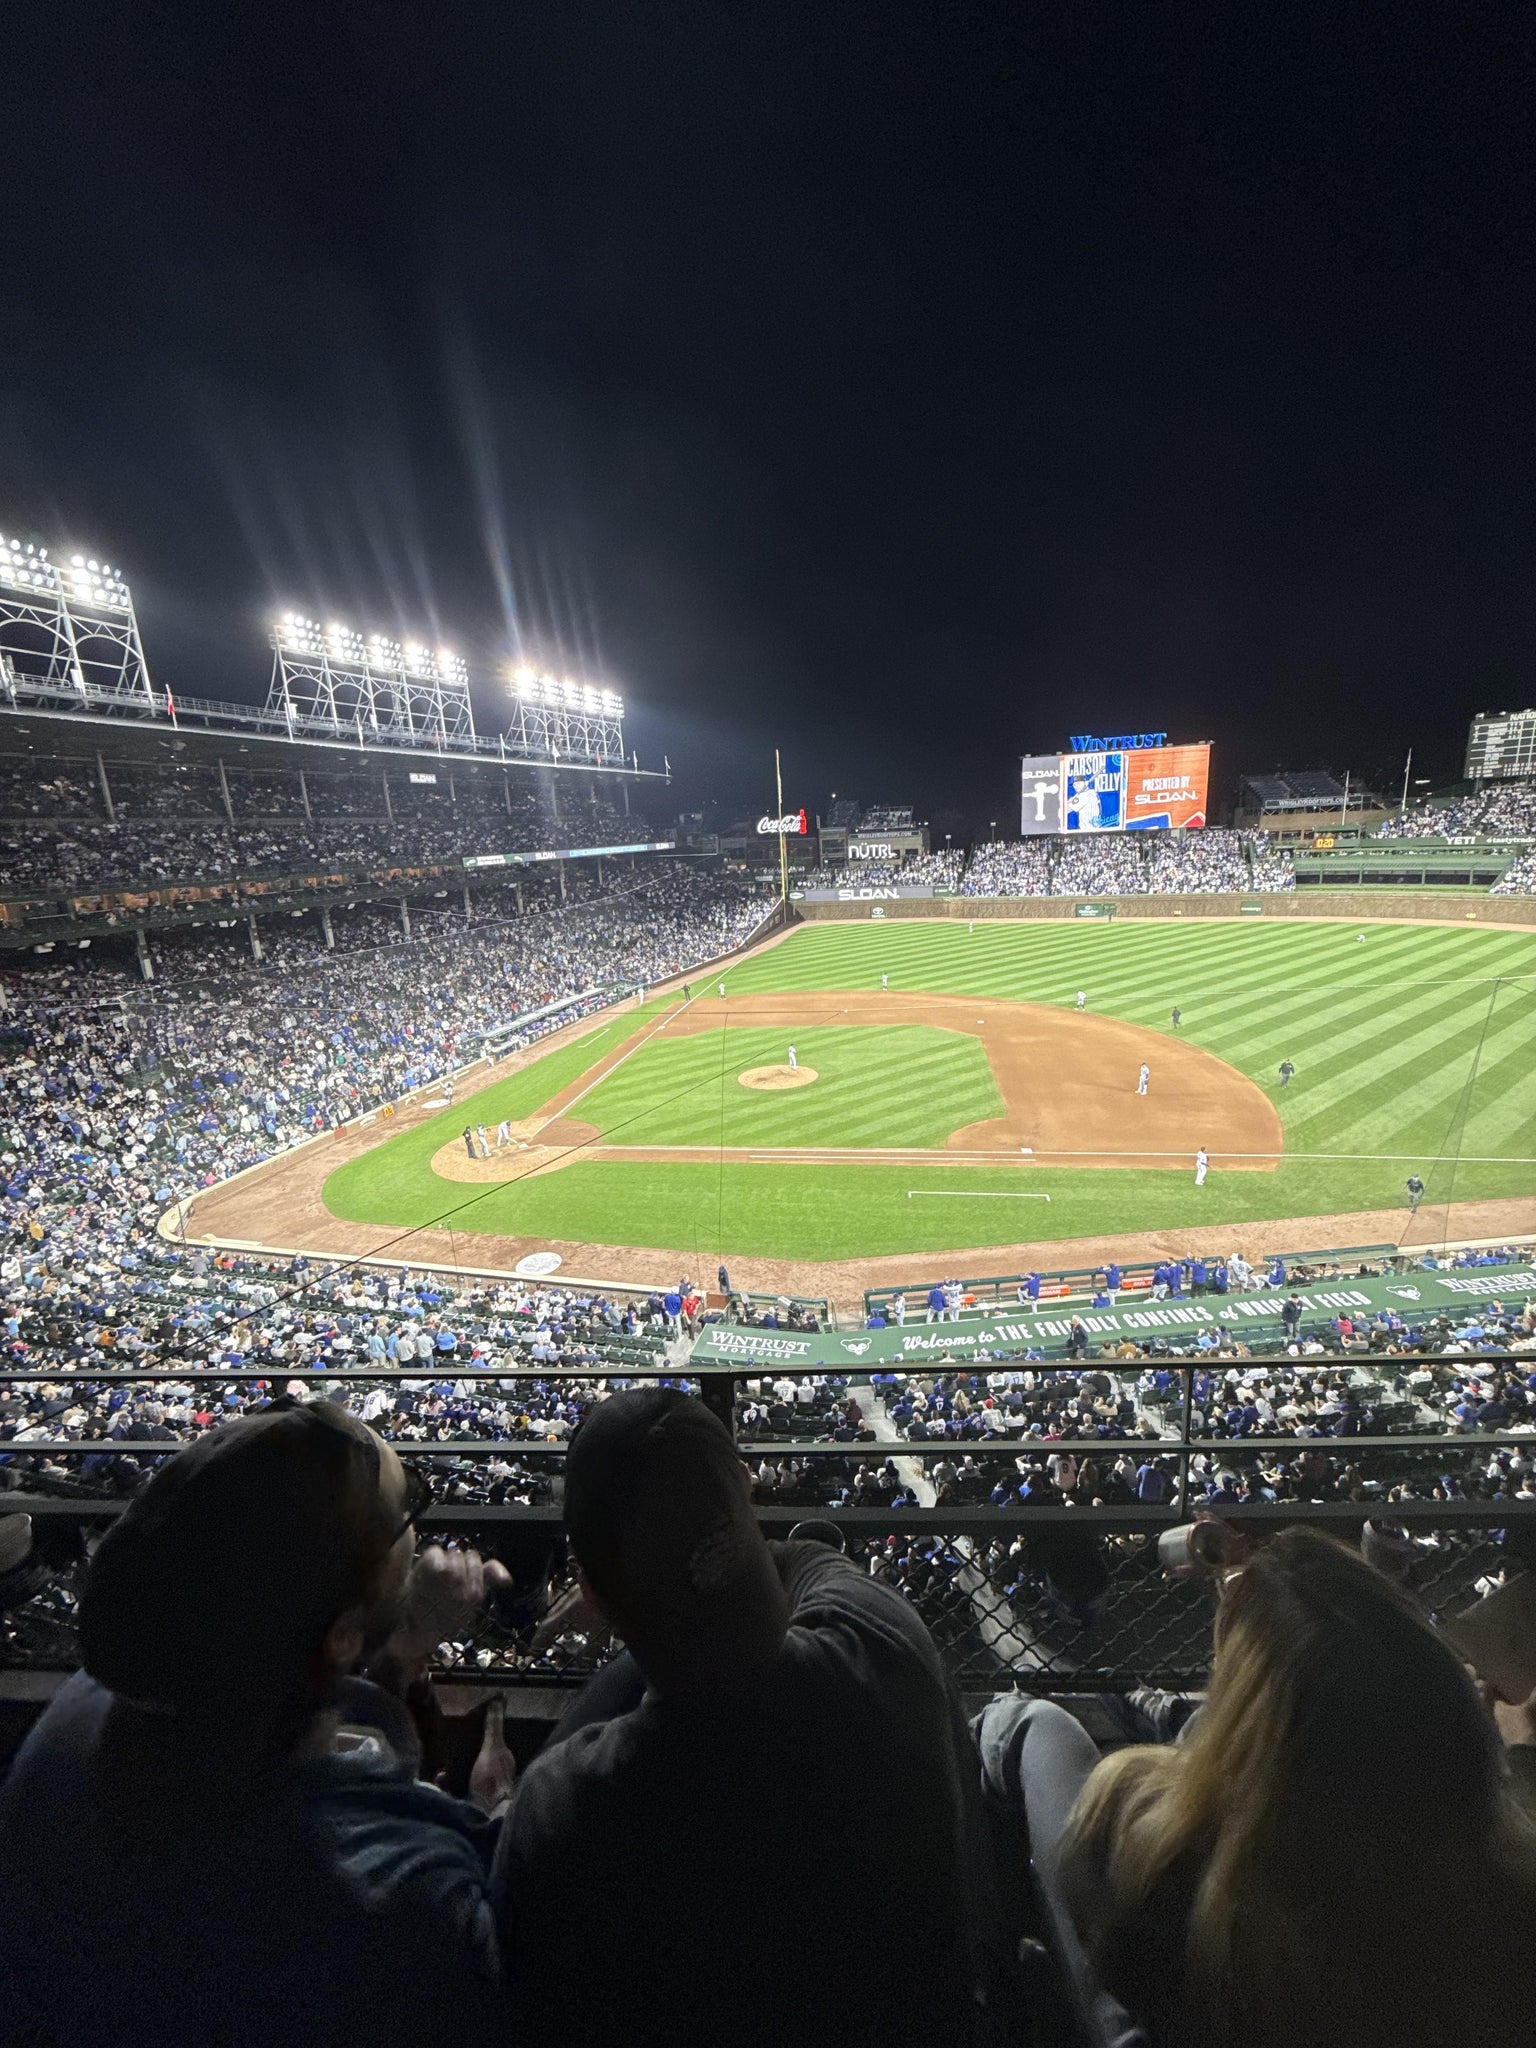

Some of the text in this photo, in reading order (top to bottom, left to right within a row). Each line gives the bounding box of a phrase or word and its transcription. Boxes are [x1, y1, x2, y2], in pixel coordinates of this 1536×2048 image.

[1069, 733, 1168, 753] WINTRUST
[1067, 755, 1106, 777] CARSON
[1095, 772, 1121, 793] KELLY
[1142, 775, 1191, 792] PRESENTED BY
[757, 815, 801, 833] CocaCola
[1446, 836, 1476, 845] YETI
[1435, 1272, 1536, 1289] WINTRUST
[902, 1333, 976, 1350] Welcome
[978, 1331, 997, 1343] to
[994, 1324, 1033, 1341] THE
[1122, 1306, 1214, 1328] CONFINES
[1219, 1305, 1239, 1320] of
[1234, 1296, 1318, 1316] WRIGY
[1313, 1290, 1372, 1308] FIELD
[711, 1330, 811, 1353] WINTRUST
[718, 1346, 791, 1359] MORTGAGE
